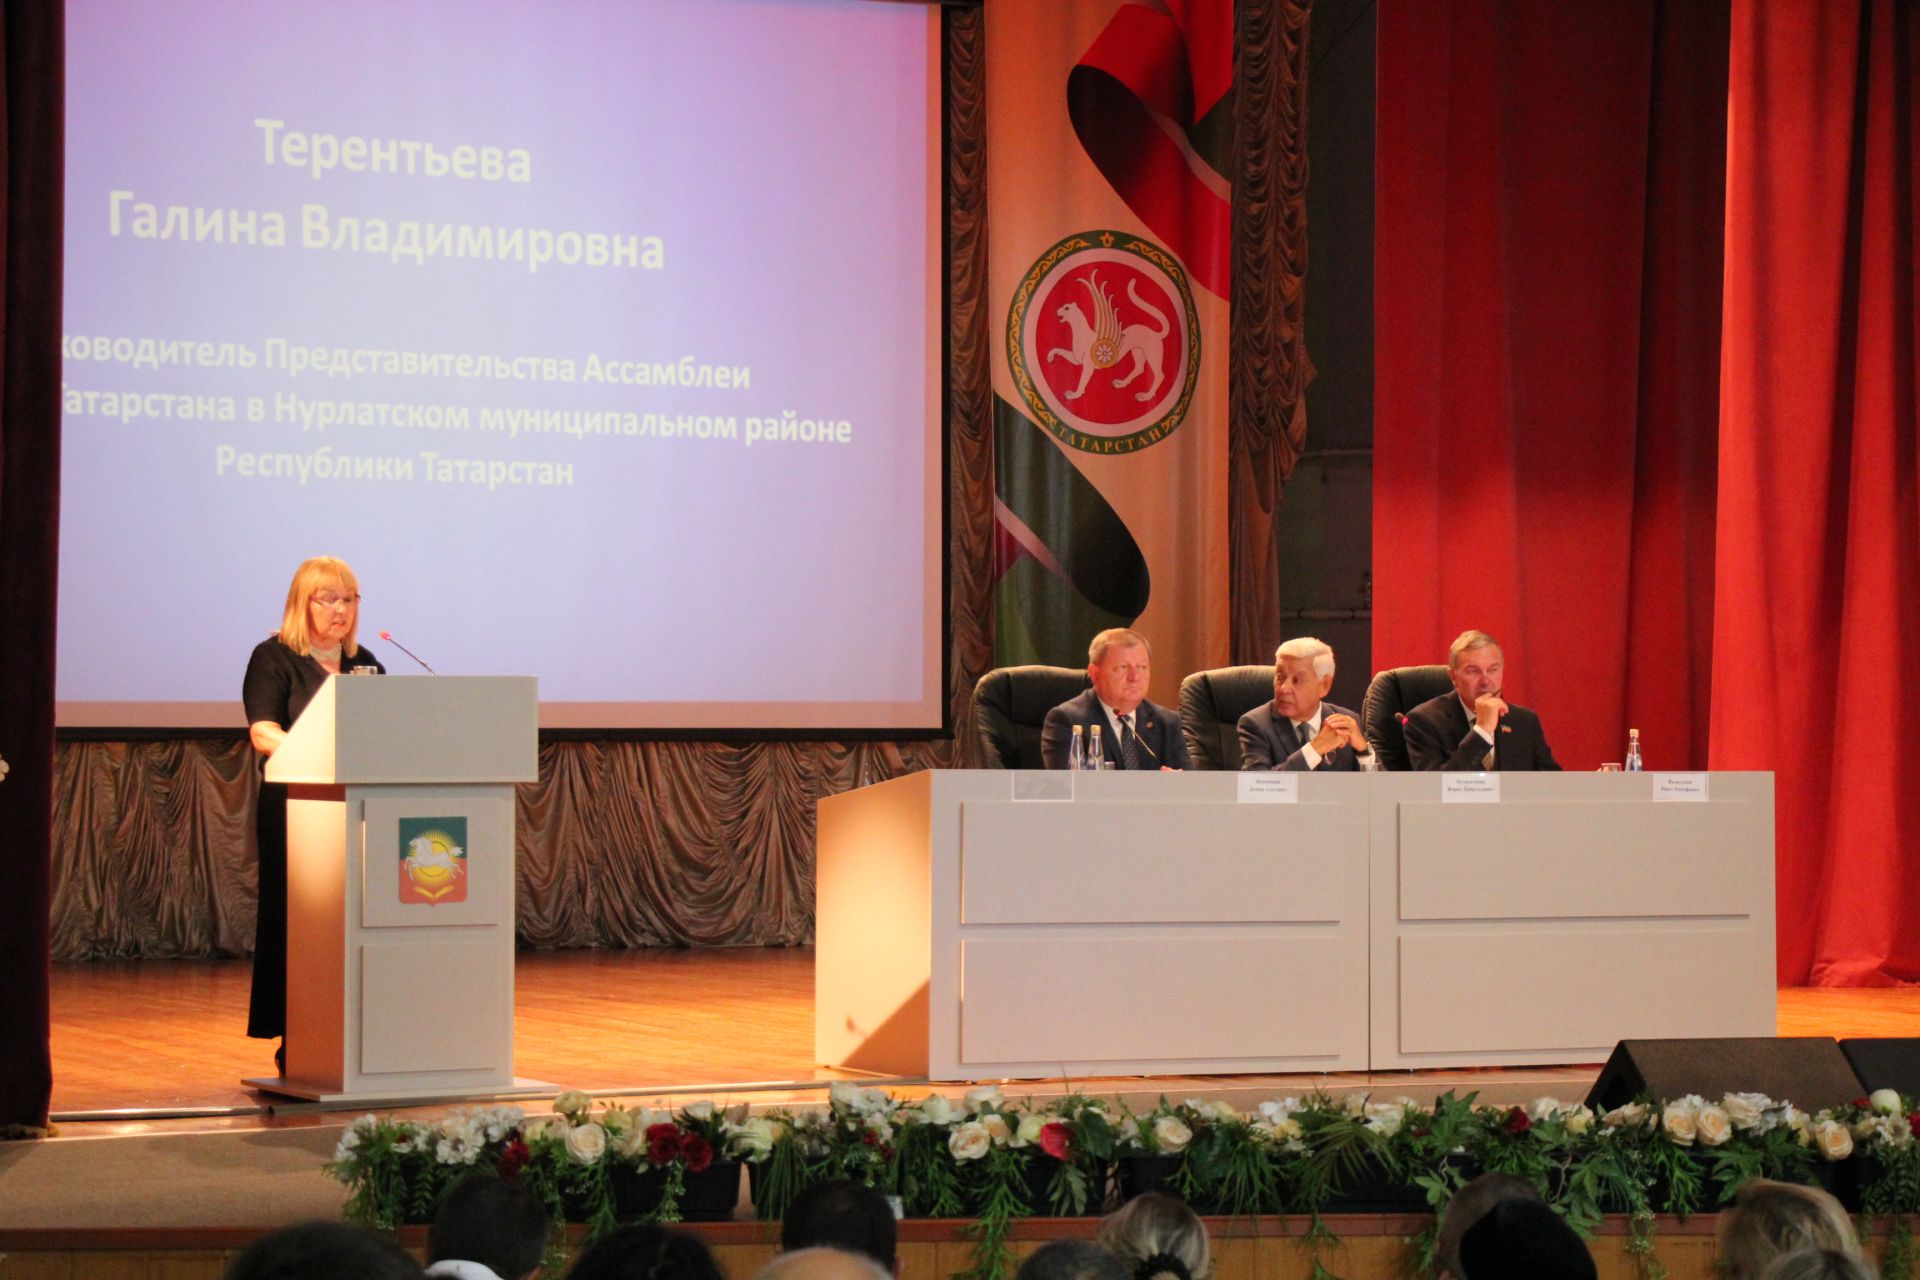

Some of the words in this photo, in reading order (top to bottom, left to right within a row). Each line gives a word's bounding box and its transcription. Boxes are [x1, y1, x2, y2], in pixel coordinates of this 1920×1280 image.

[254, 118, 531, 183] Терентьева
[109, 190, 287, 247] Галина
[302, 204, 665, 274] Владимировна
[265, 337, 576, 382] Представительства
[583, 353, 751, 390] Ассамблеи
[62, 382, 235, 424] атарстана
[247, 397, 265, 421] в
[275, 392, 470, 431] Нурлатском
[479, 406, 738, 440] муниципальном
[745, 410, 852, 447] районе
[1058, 426, 1162, 453] ТАТАРСТАН
[216, 445, 414, 485] Республики
[421, 451, 574, 491] Татарстан
